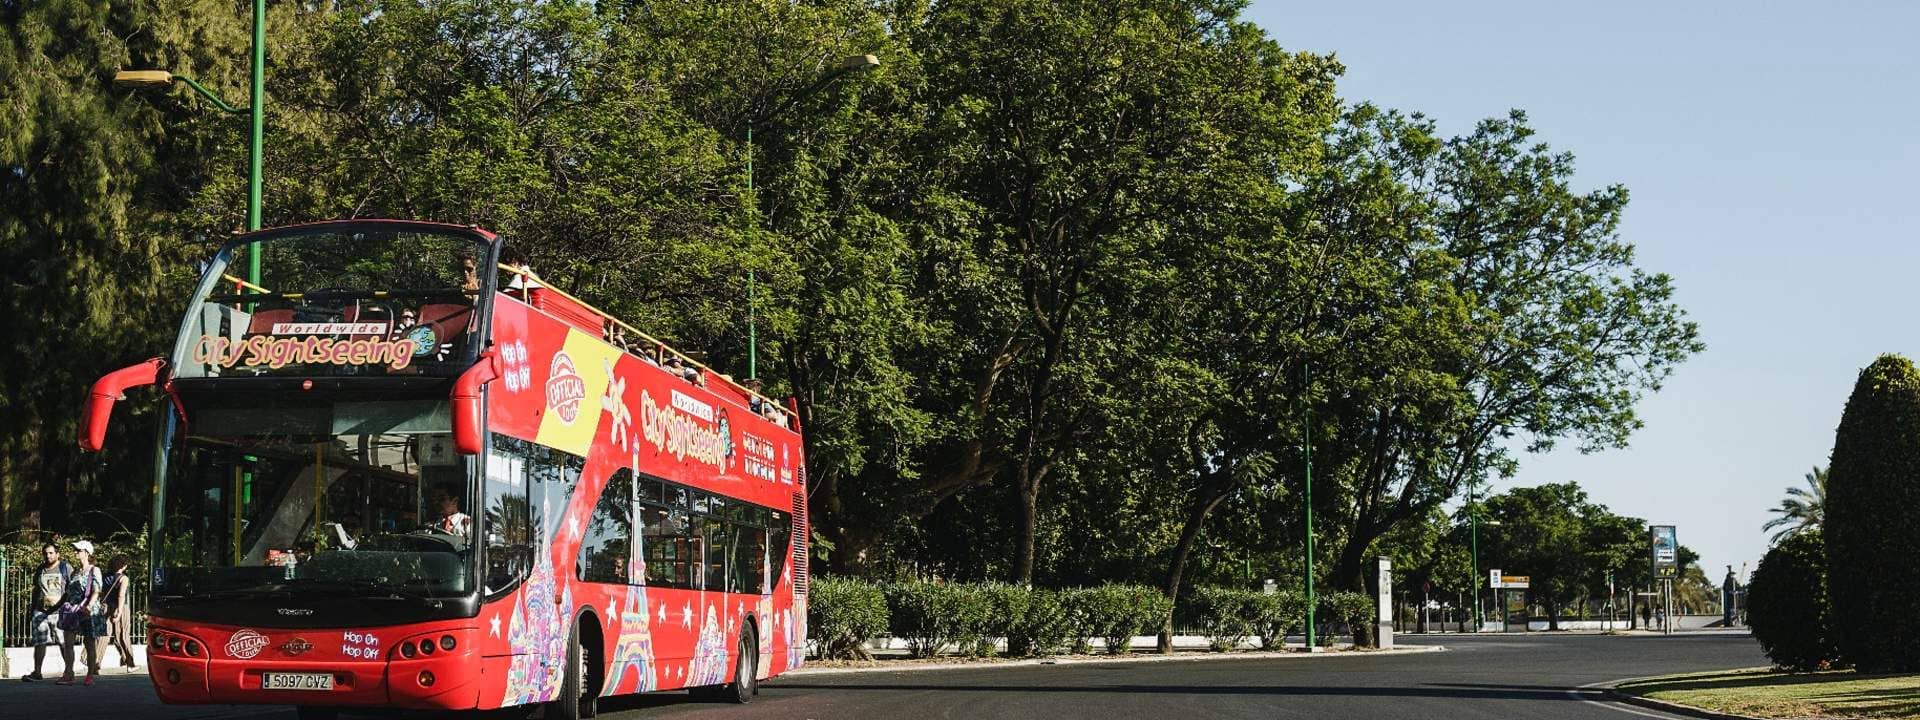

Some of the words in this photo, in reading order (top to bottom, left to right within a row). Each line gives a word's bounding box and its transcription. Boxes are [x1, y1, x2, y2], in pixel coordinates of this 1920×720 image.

[278, 323, 380, 334] Worldwide
[229, 636, 267, 653] OFFICIAL
[343, 631, 362, 645] Hop
[364, 633, 379, 646] On
[342, 645, 361, 658] Hop
[363, 647, 380, 660] Off
[274, 675, 303, 688] 5097
[306, 675, 331, 689] CVZ
